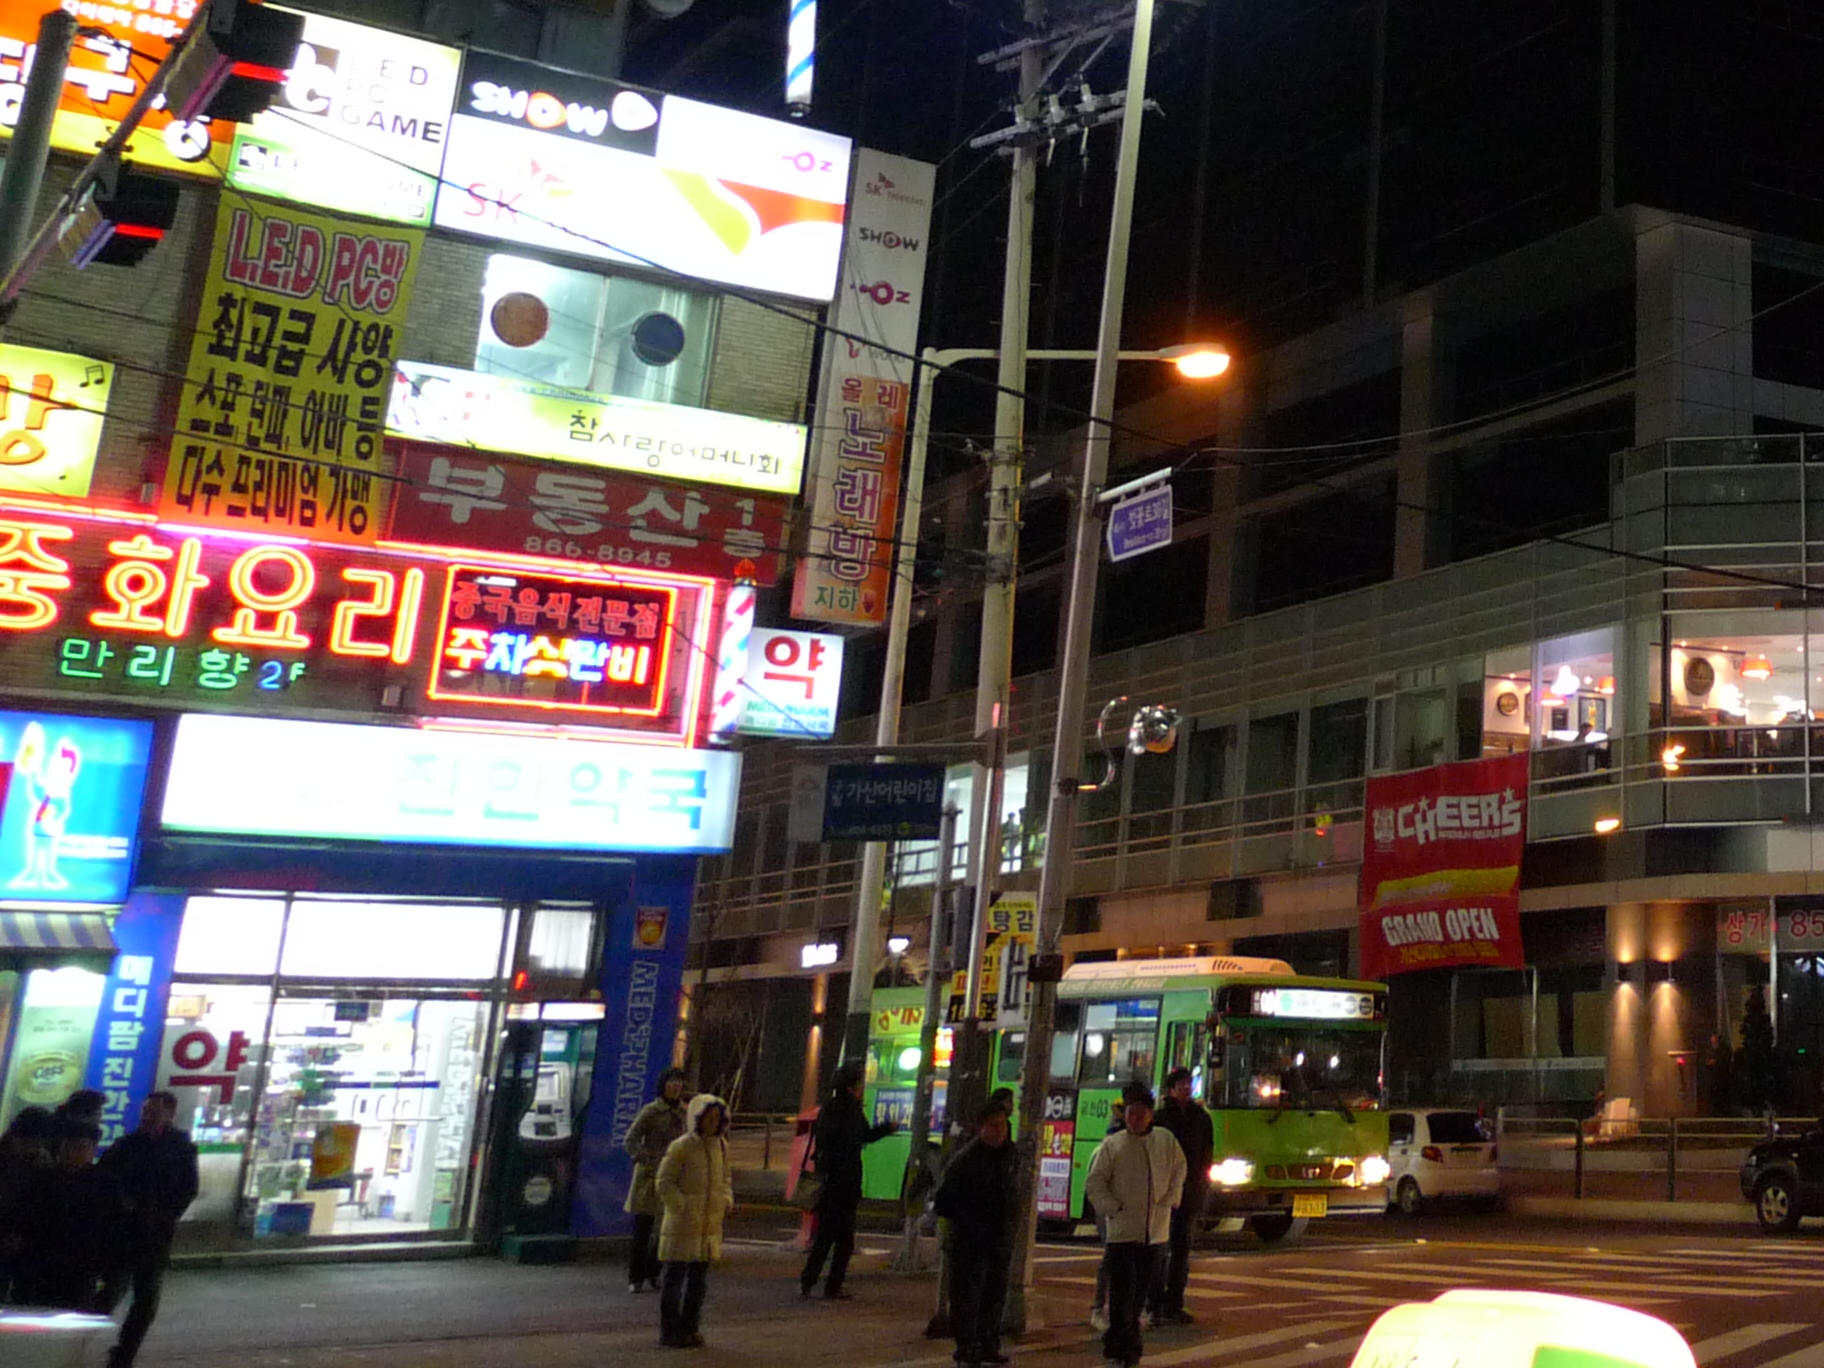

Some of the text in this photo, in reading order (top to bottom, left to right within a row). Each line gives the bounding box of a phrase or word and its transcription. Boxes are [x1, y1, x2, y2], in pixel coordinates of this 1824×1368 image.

[340, 104, 444, 144] GAME
[470, 79, 608, 137] SHOW
[463, 182, 524, 225] SK
[859, 226, 919, 252] SHOW
[321, 230, 412, 315] PC방
[206, 291, 394, 390] 최고급 사양
[175, 444, 372, 536] 다수 프리미엄 가맹
[418, 457, 710, 549] 부동산
[827, 410, 886, 582] 노래방
[523, 535, 673, 569] 866-8945
[0, 518, 425, 665] 중화요리
[813, 584, 859, 613] 지하
[60, 636, 251, 690] 만리향
[763, 635, 826, 700] 약
[1397, 787, 1524, 846] CHEERS
[1381, 907, 1501, 947] GRAND OPEN
[1725, 909, 1769, 944] 상가
[106, 954, 154, 1051] 메디팜
[169, 1030, 251, 1106] 약
